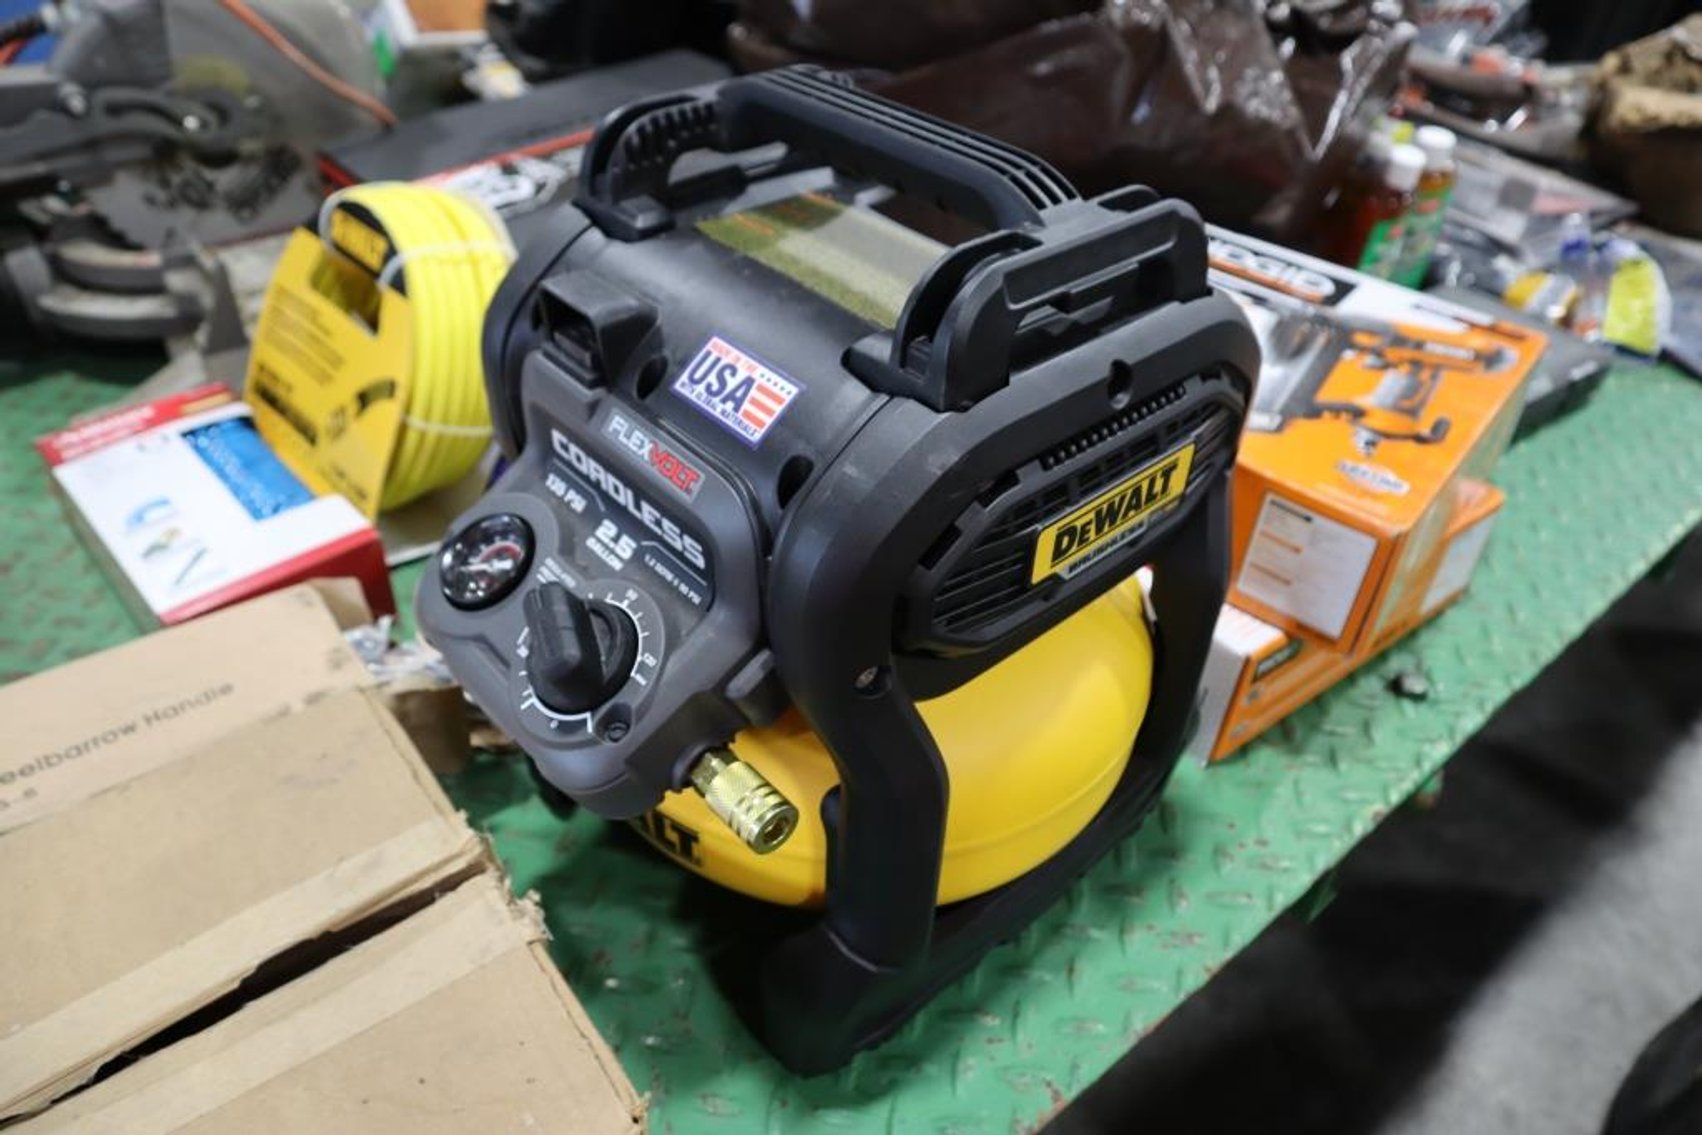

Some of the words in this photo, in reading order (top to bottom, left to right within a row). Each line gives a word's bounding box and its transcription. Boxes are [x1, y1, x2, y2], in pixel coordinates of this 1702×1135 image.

[688, 350, 756, 414] USA
[609, 415, 699, 493] FLEXVOLT
[551, 429, 705, 569] CORDLESS
[595, 519, 637, 560] 2.5
[0, 721, 137, 785] eelbarrow
[142, 684, 234, 727] Handle
